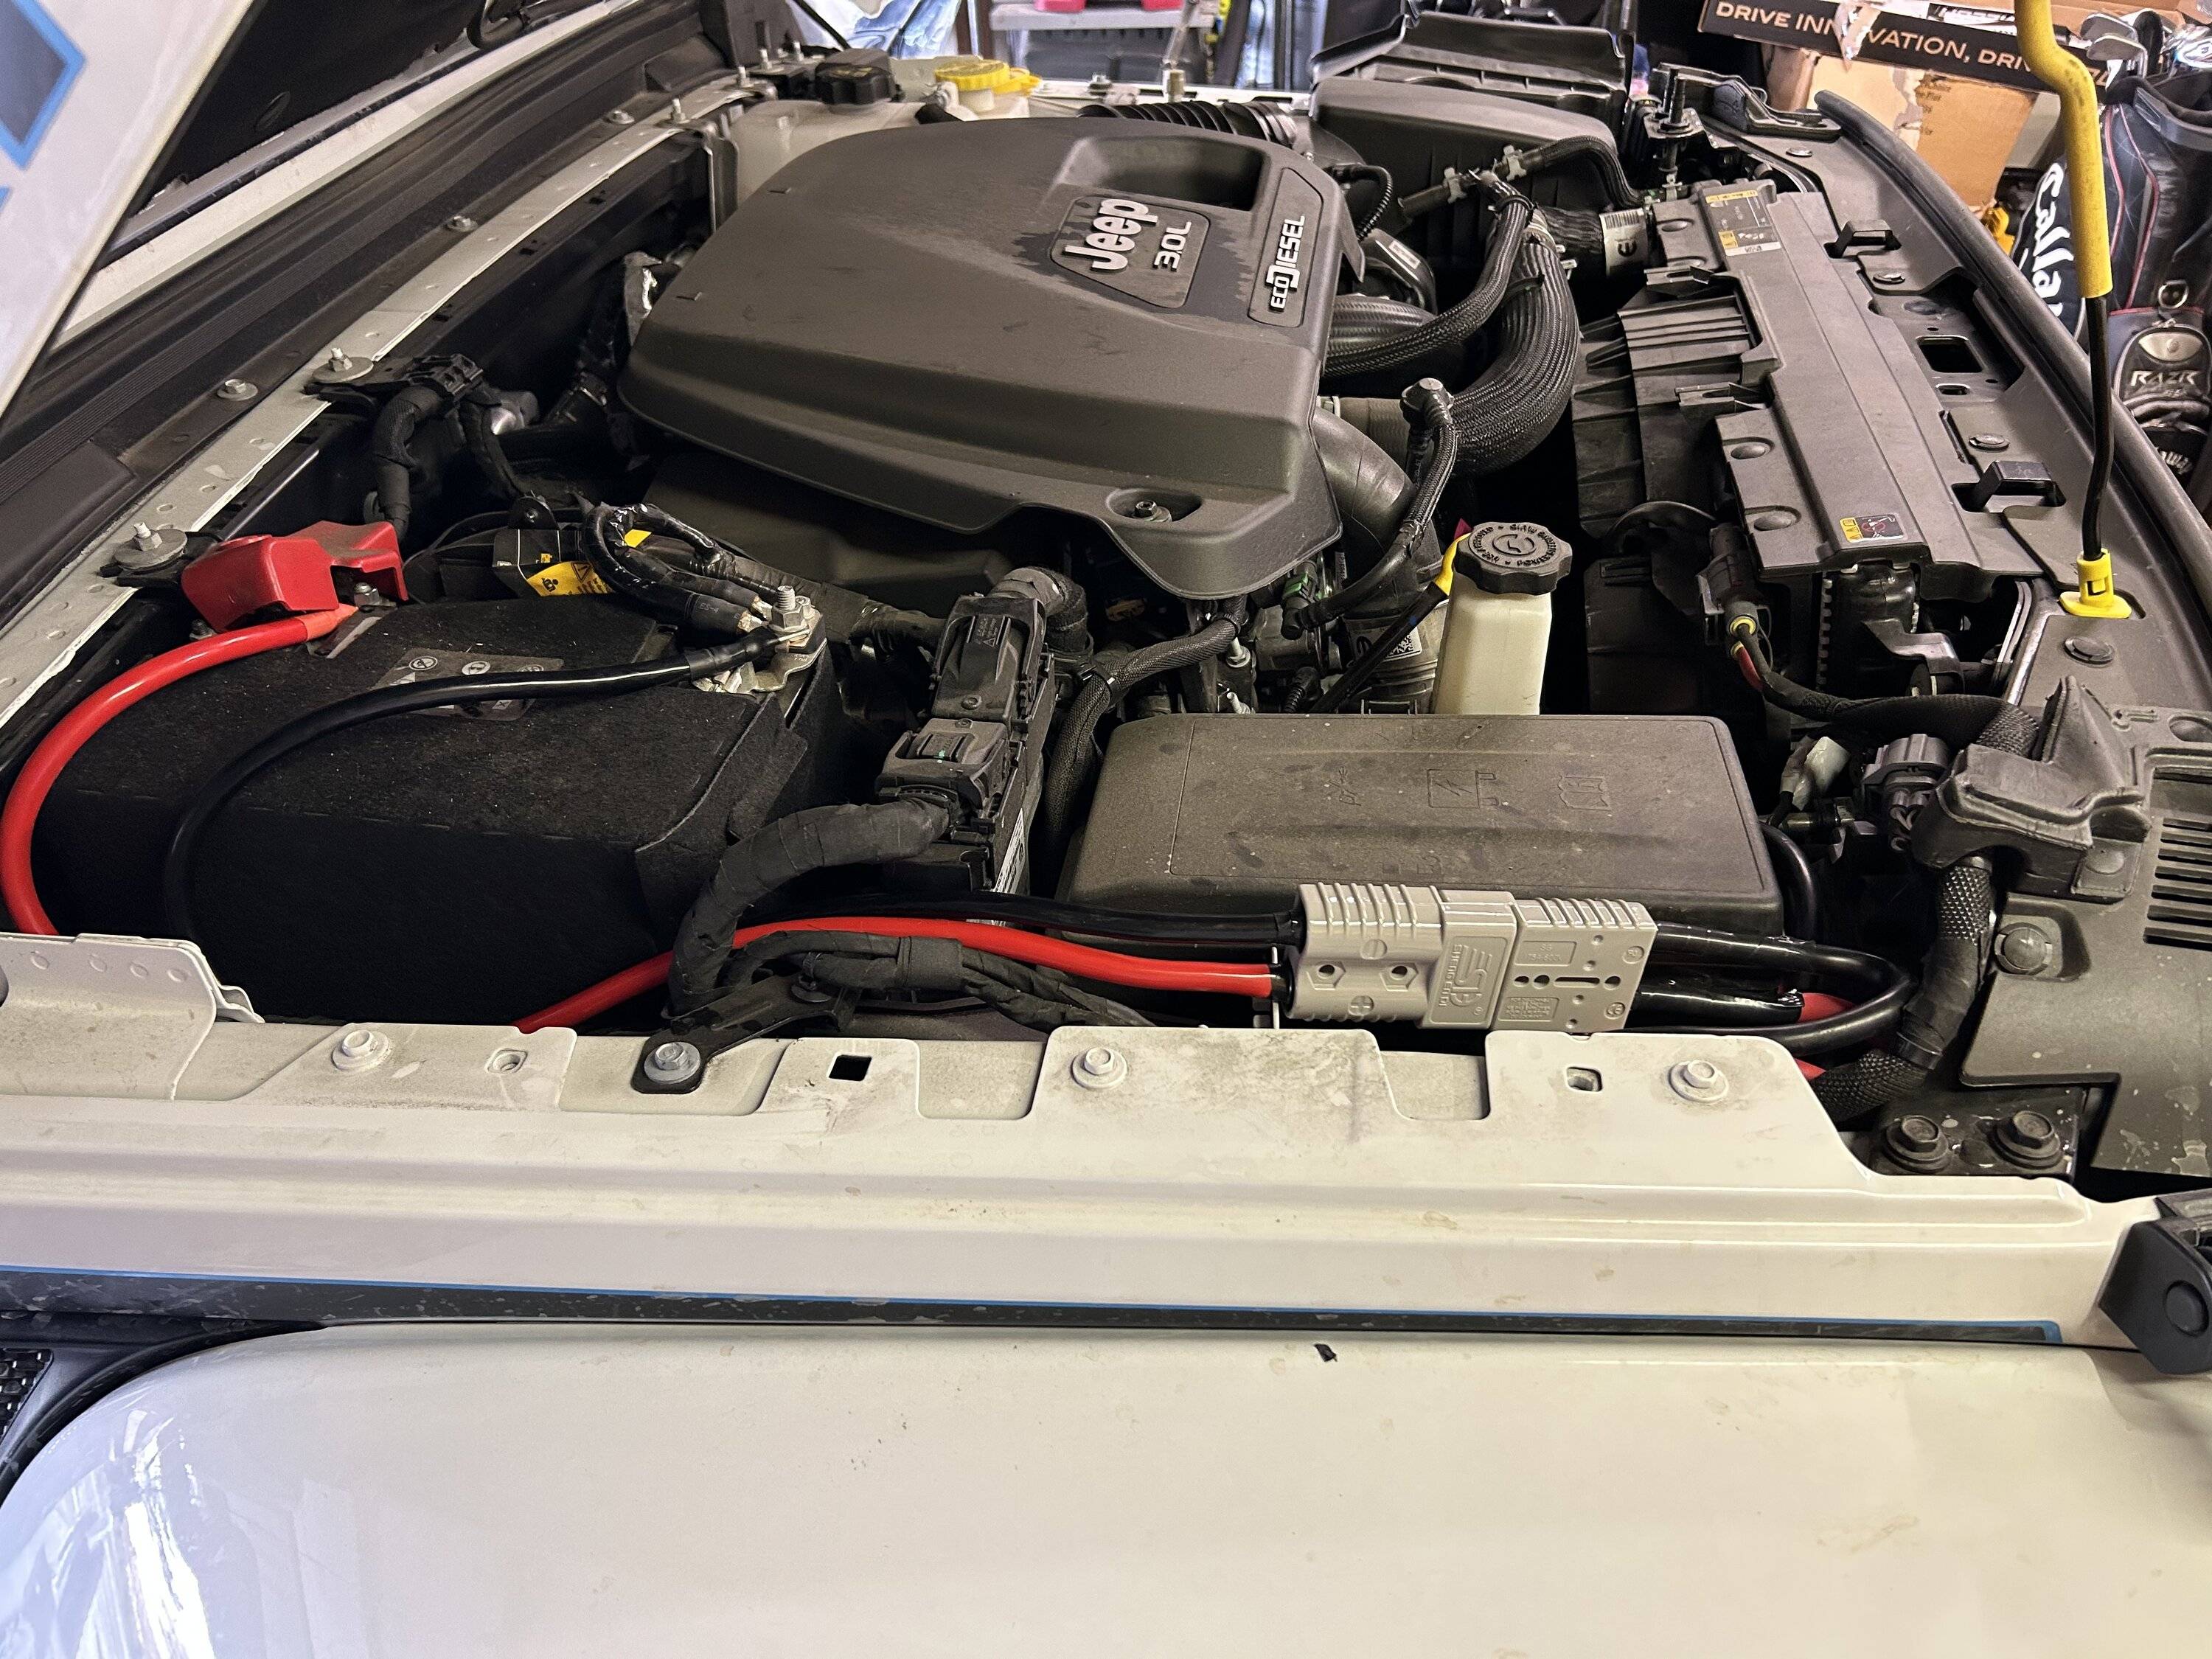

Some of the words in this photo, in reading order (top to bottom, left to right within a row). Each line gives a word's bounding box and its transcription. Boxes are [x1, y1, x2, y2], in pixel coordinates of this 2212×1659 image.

[1715, 1, 1792, 28] DRIVE
[1795, 13, 1971, 63] INNVATION,
[1978, 49, 2032, 72] DRI
[1064, 198, 1158, 271] Jeep
